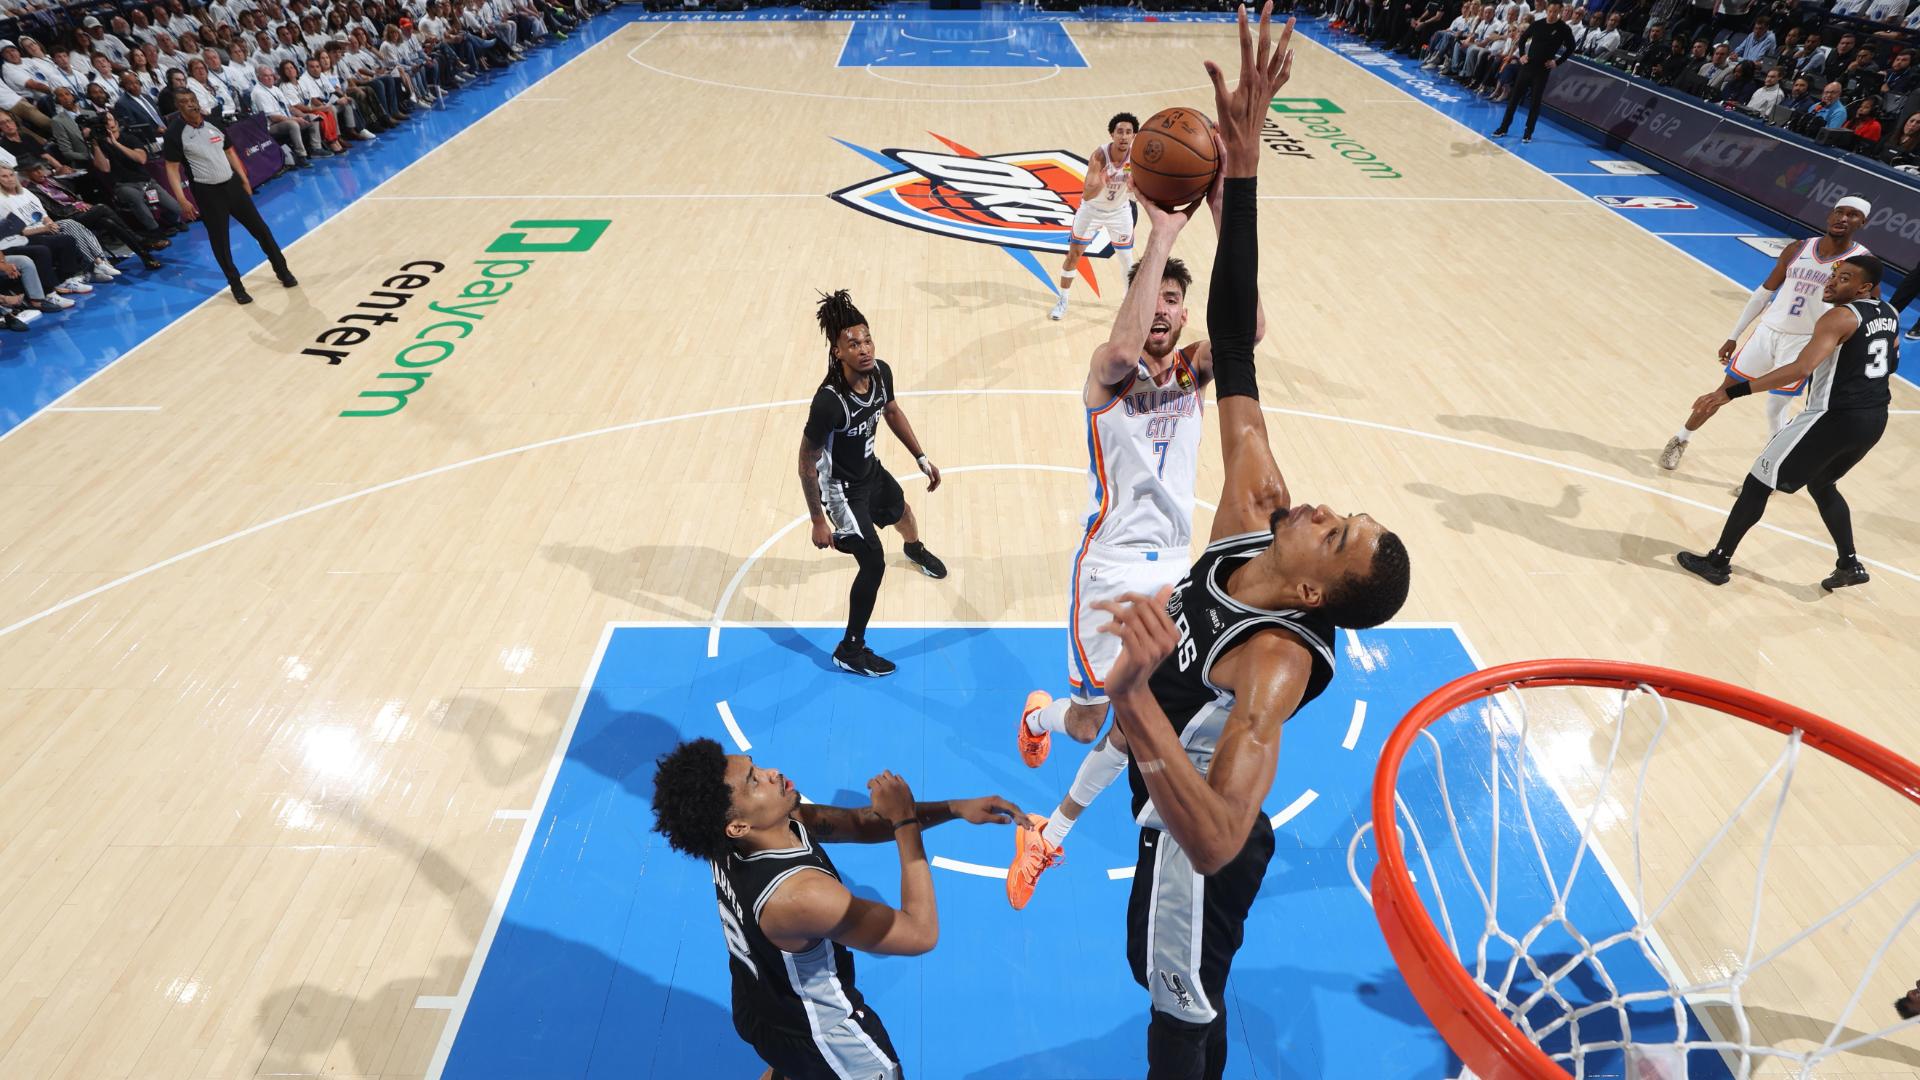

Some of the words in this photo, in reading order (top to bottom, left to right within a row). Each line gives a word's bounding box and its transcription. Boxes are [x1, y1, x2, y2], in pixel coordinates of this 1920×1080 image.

[1613, 97, 1652, 126] TUES
[1649, 112, 1681, 139] 6/2
[1260, 117, 1316, 160] enter
[1284, 116, 1403, 178] paycom
[1683, 130, 1782, 170] AGT
[897, 151, 1077, 227] OKC
[1106, 190, 1116, 201] 3
[1807, 178, 1849, 208] NB
[300, 260, 445, 365] center
[1789, 296, 1806, 316] 2
[338, 259, 535, 417] paycom
[1865, 317, 1897, 337] JOHNSON
[1864, 338, 1889, 378] 3
[864, 435, 875, 459] 5
[1146, 416, 1180, 438] CITY
[1153, 440, 1170, 481] 7
[718, 900, 759, 981] 2
